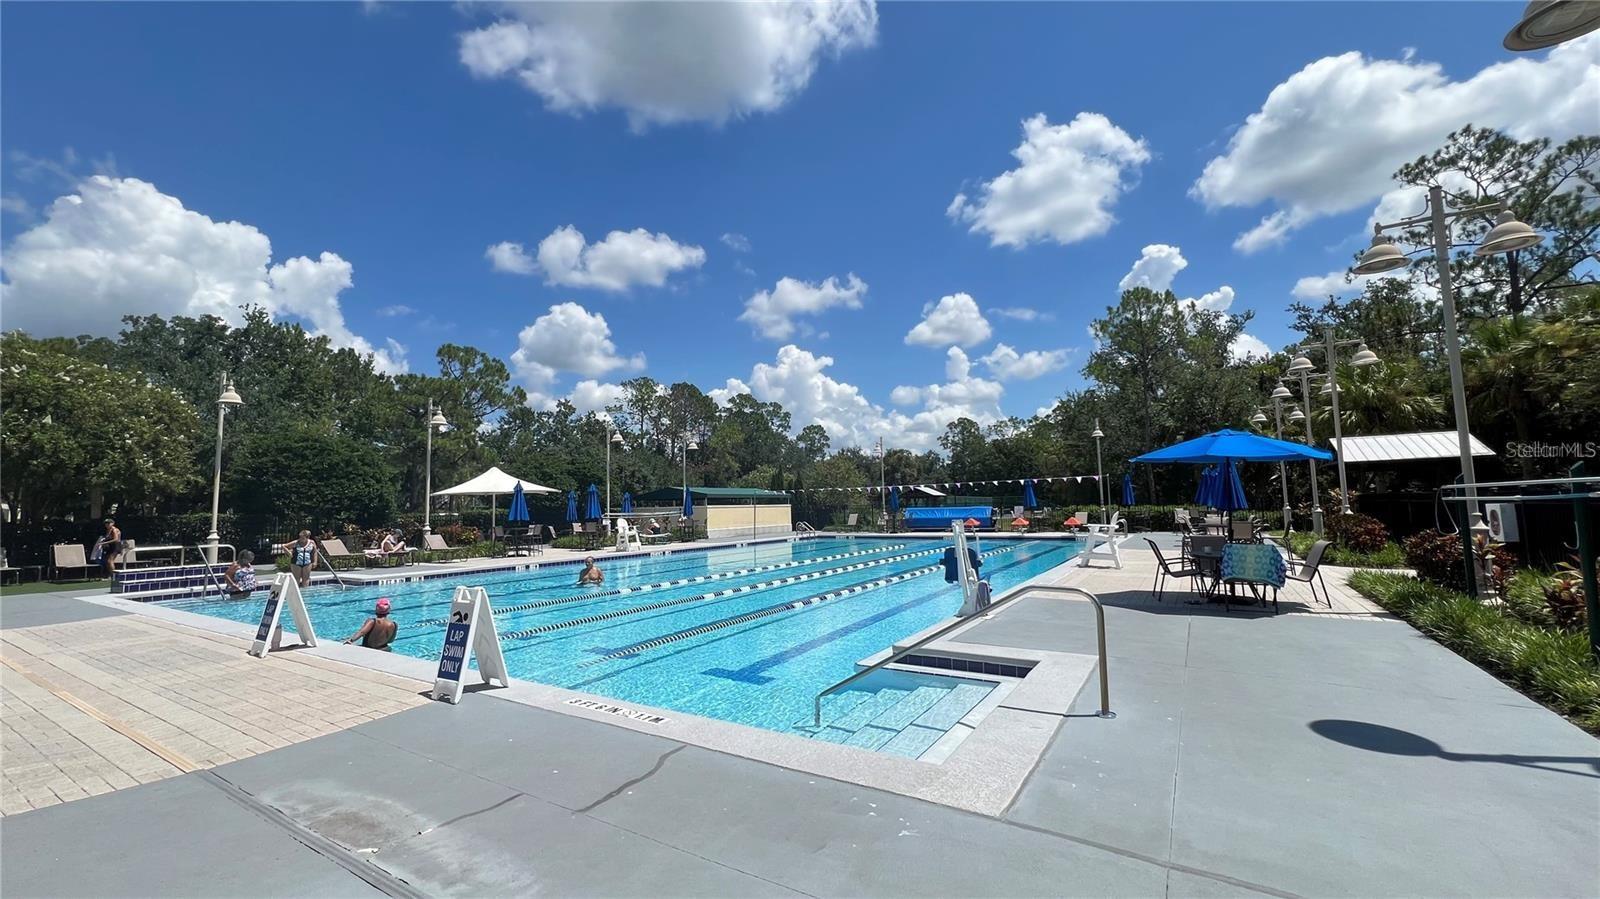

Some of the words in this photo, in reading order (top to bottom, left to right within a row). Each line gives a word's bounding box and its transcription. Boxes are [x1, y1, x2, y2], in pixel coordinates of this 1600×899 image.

[449, 629, 465, 642] LAP
[443, 644, 465, 658] SWIM
[441, 659, 460, 674] ONLY
